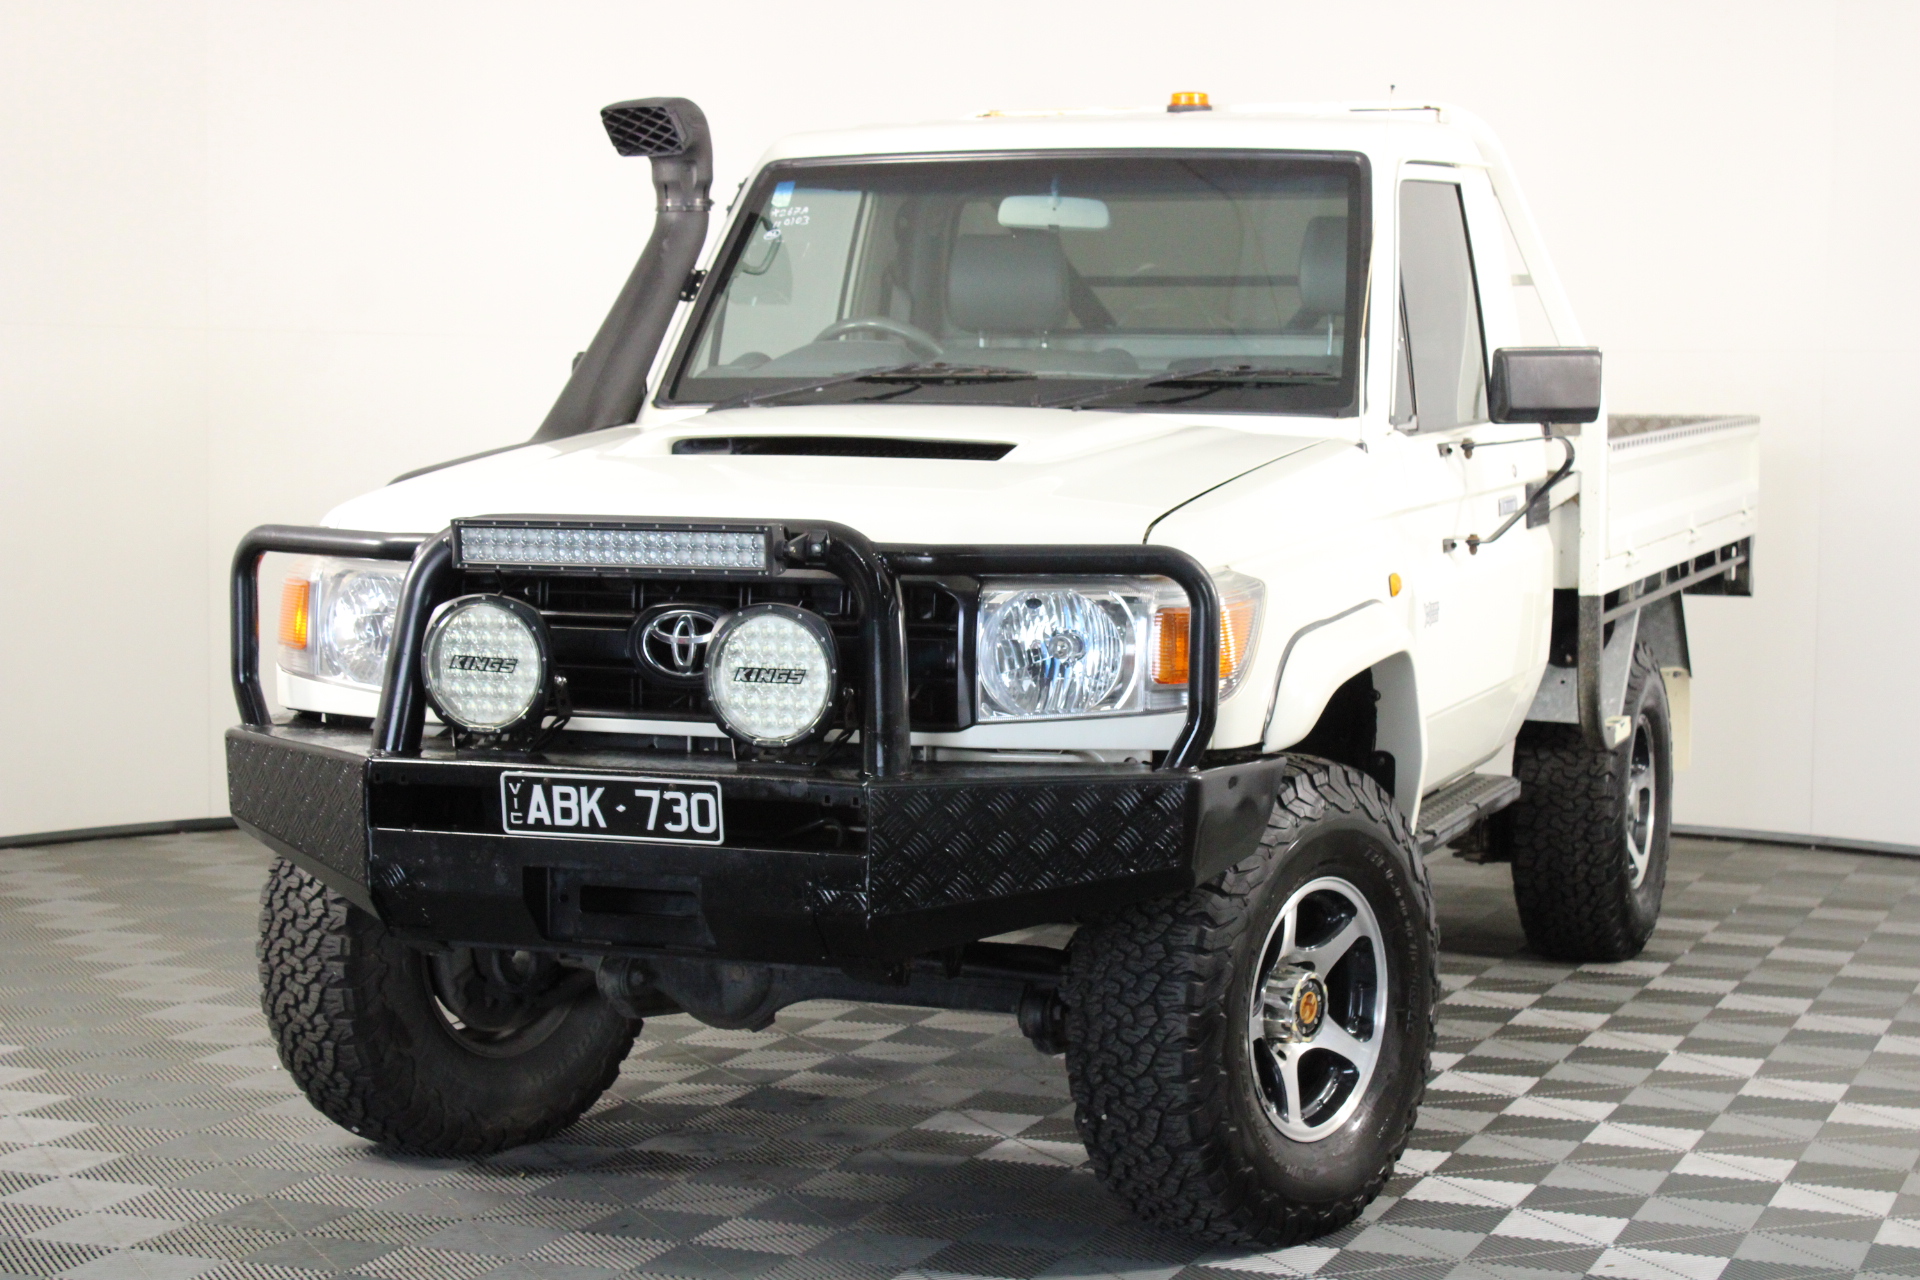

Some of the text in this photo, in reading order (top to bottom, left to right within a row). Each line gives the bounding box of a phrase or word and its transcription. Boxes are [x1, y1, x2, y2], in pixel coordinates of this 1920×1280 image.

[449, 654, 518, 673] KINGS
[733, 666, 807, 684] KINGS
[508, 782, 523, 825] VIC
[526, 784, 718, 834] ABK 730
